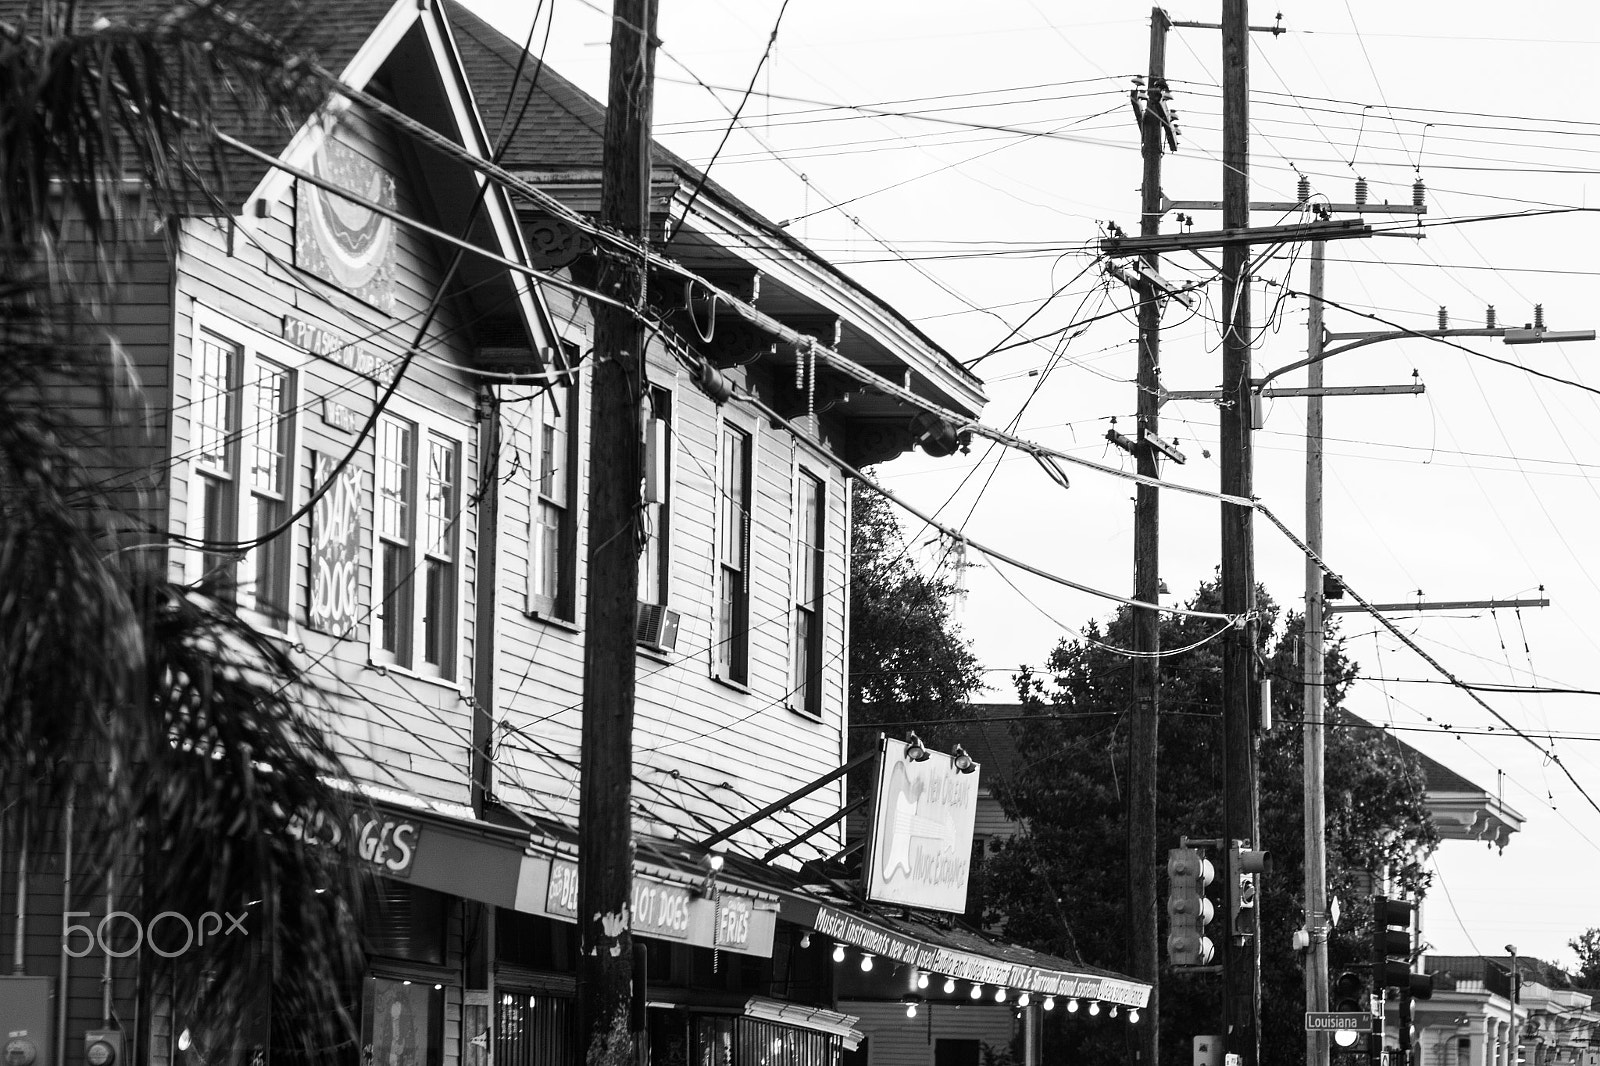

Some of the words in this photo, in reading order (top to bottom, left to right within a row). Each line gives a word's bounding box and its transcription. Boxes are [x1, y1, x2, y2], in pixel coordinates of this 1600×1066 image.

[316, 556, 356, 621] DOG
[657, 890, 690, 931] DOGS
[718, 907, 749, 943] FRIES
[813, 906, 849, 939] Musical
[845, 918, 891, 956] instruments
[888, 937, 906, 961] new
[902, 943, 920, 966] and
[916, 948, 938, 970] used
[931, 951, 954, 975] Audio
[1308, 1015, 1358, 1028] Louisiana
